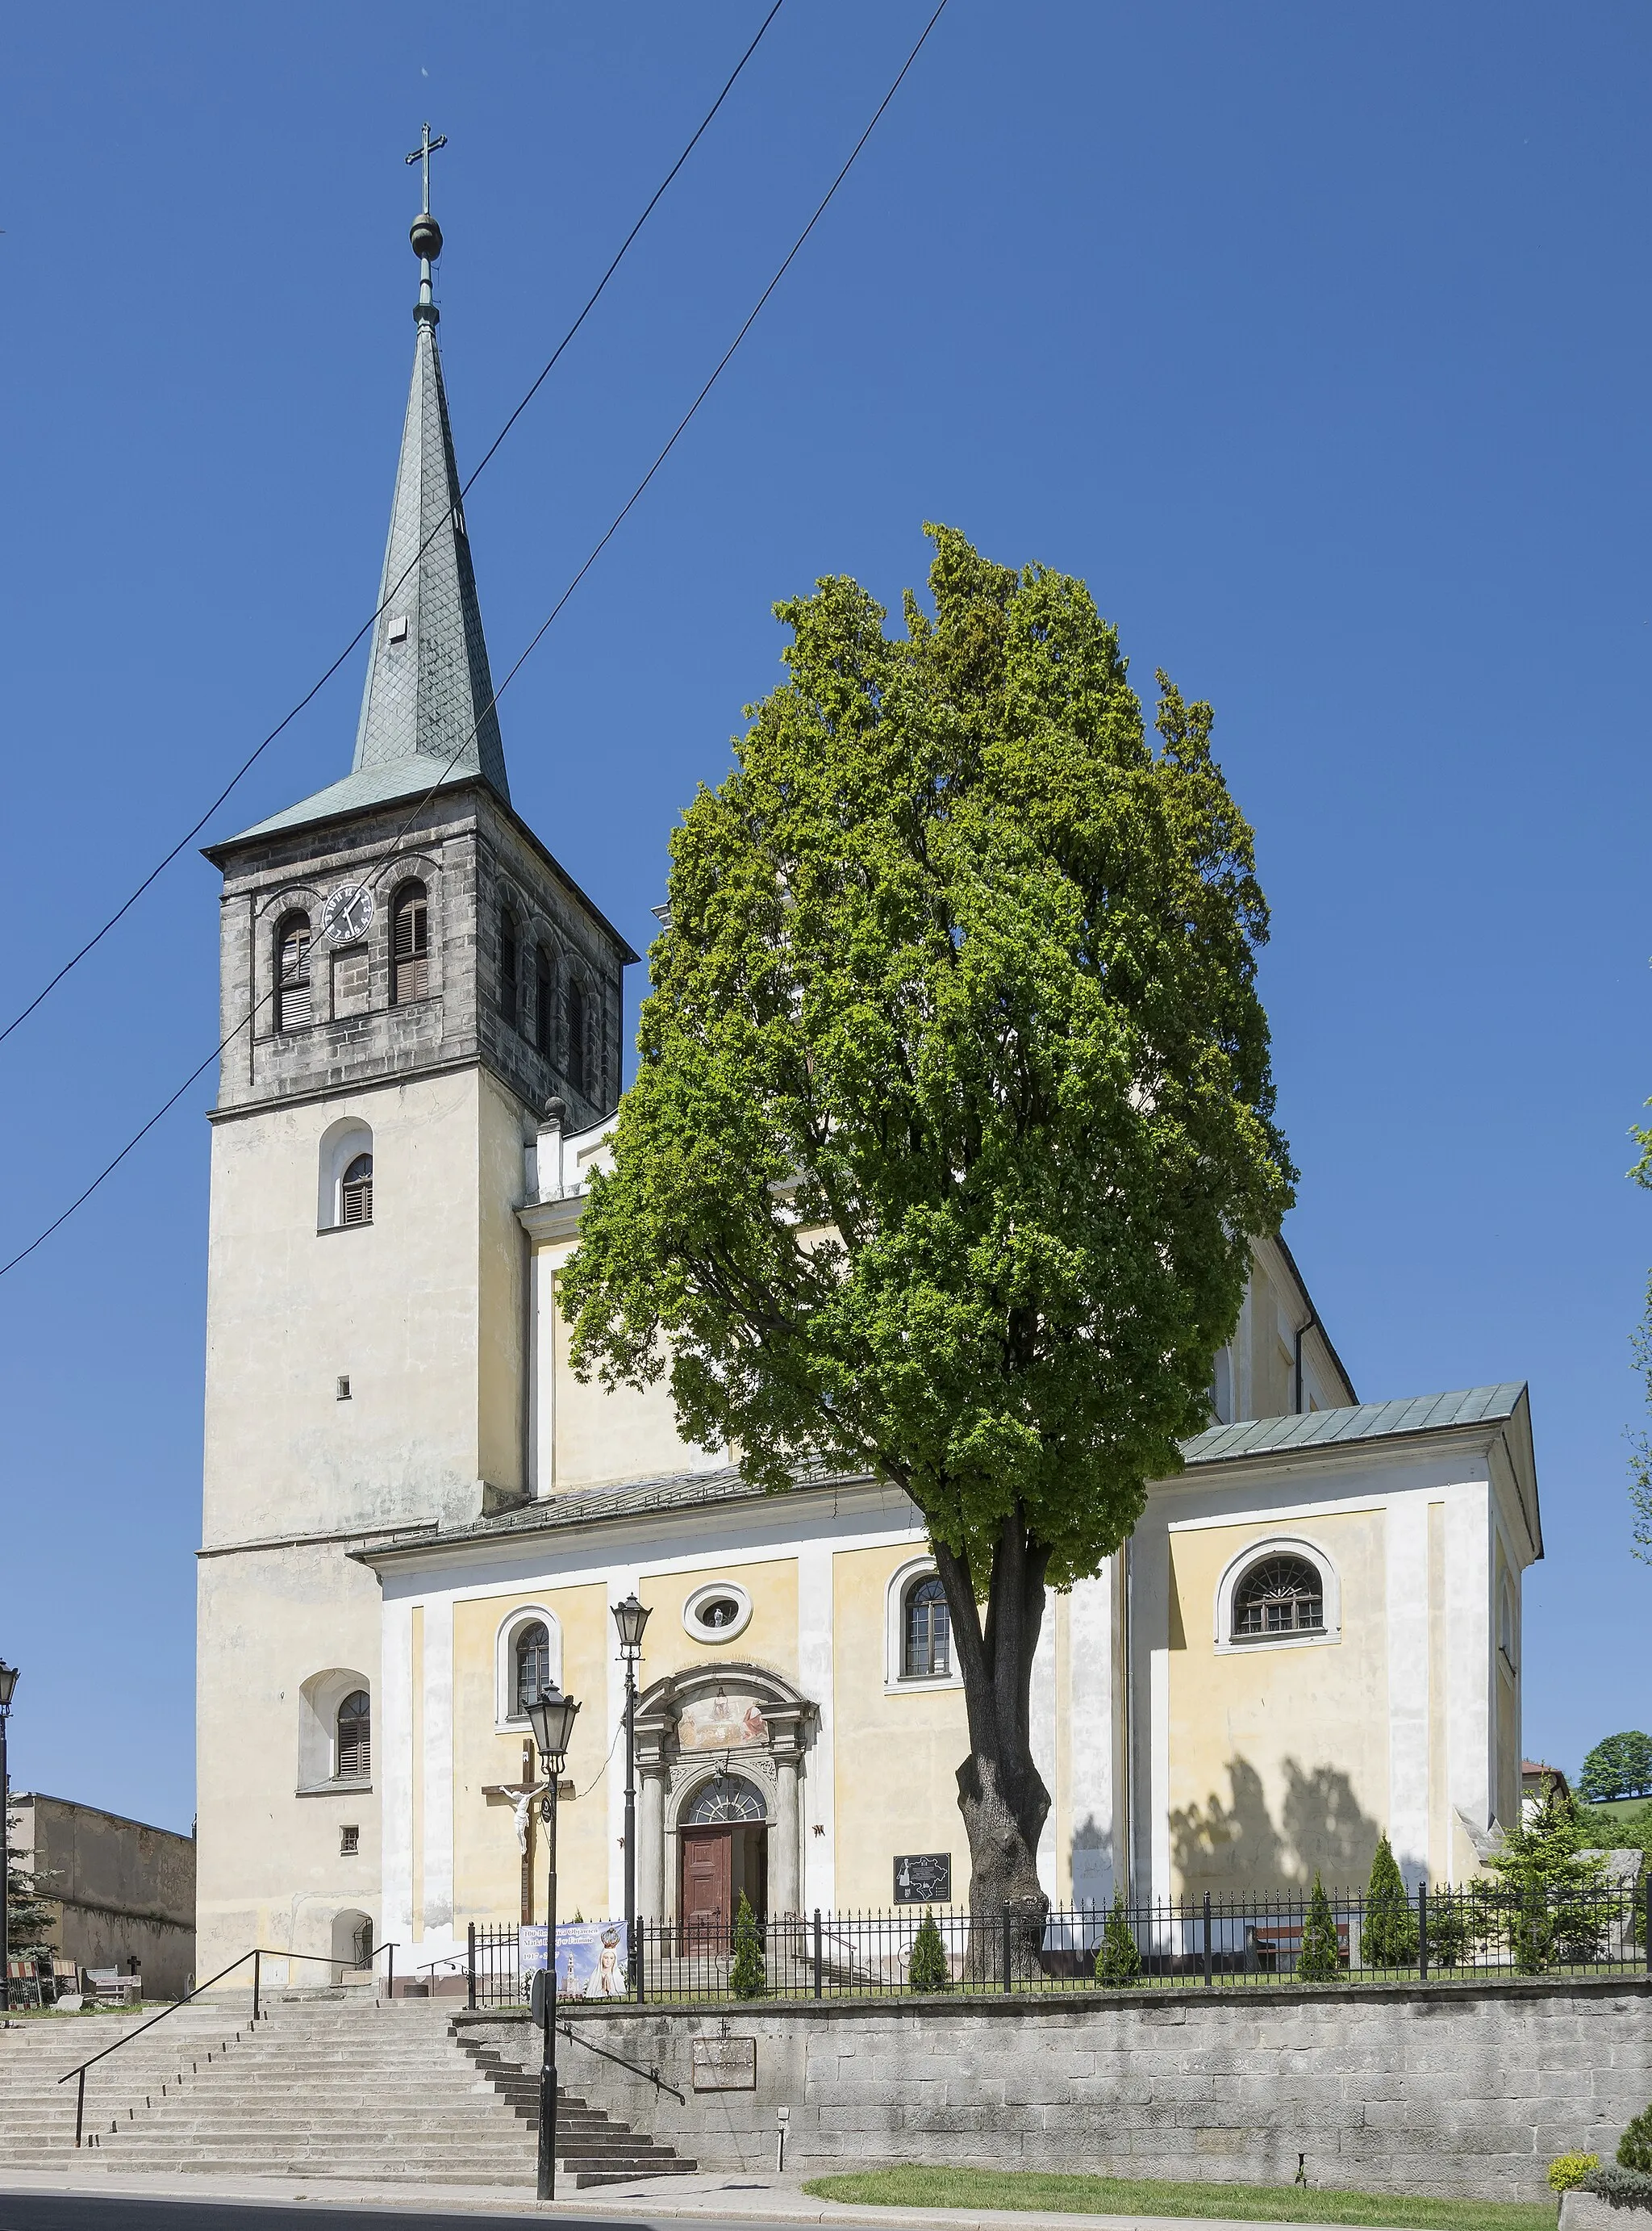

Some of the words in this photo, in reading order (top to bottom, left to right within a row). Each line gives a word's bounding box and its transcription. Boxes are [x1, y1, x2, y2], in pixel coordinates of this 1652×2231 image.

[344, 888, 353, 897] 12
[361, 896, 369, 904] 2
[327, 900, 336, 911] 10
[335, 930, 342, 938] 7
[354, 925, 361, 934] 5
[344, 930, 351, 939] 6
[543, 1938, 561, 1946] Bej
